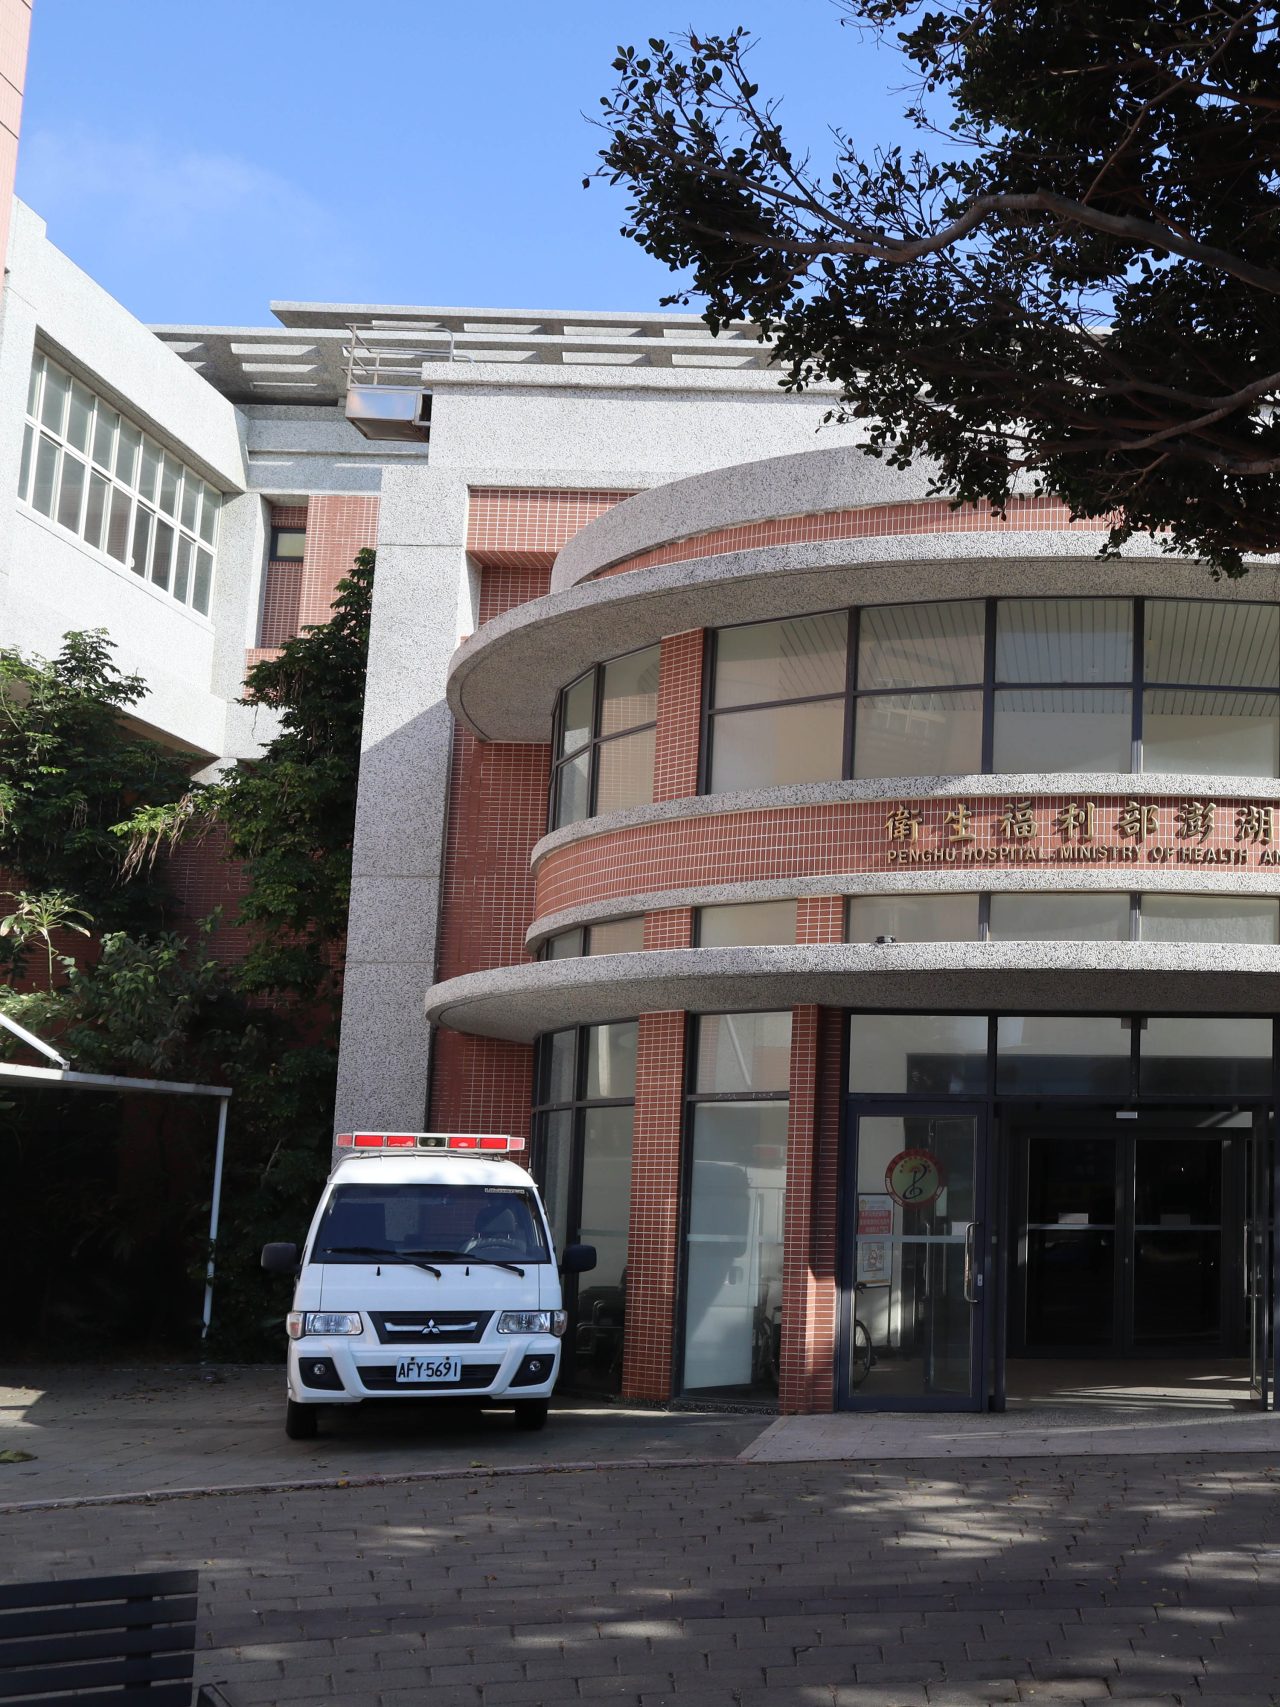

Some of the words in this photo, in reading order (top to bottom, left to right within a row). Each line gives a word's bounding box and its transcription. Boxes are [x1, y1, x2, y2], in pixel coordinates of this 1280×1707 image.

[887, 848, 956, 864] PENGHU
[1060, 844, 1142, 863] MINISTRY
[1152, 846, 1175, 864] OF
[1181, 847, 1249, 867] HEALTH
[398, 1361, 458, 1378] AFY-5691
